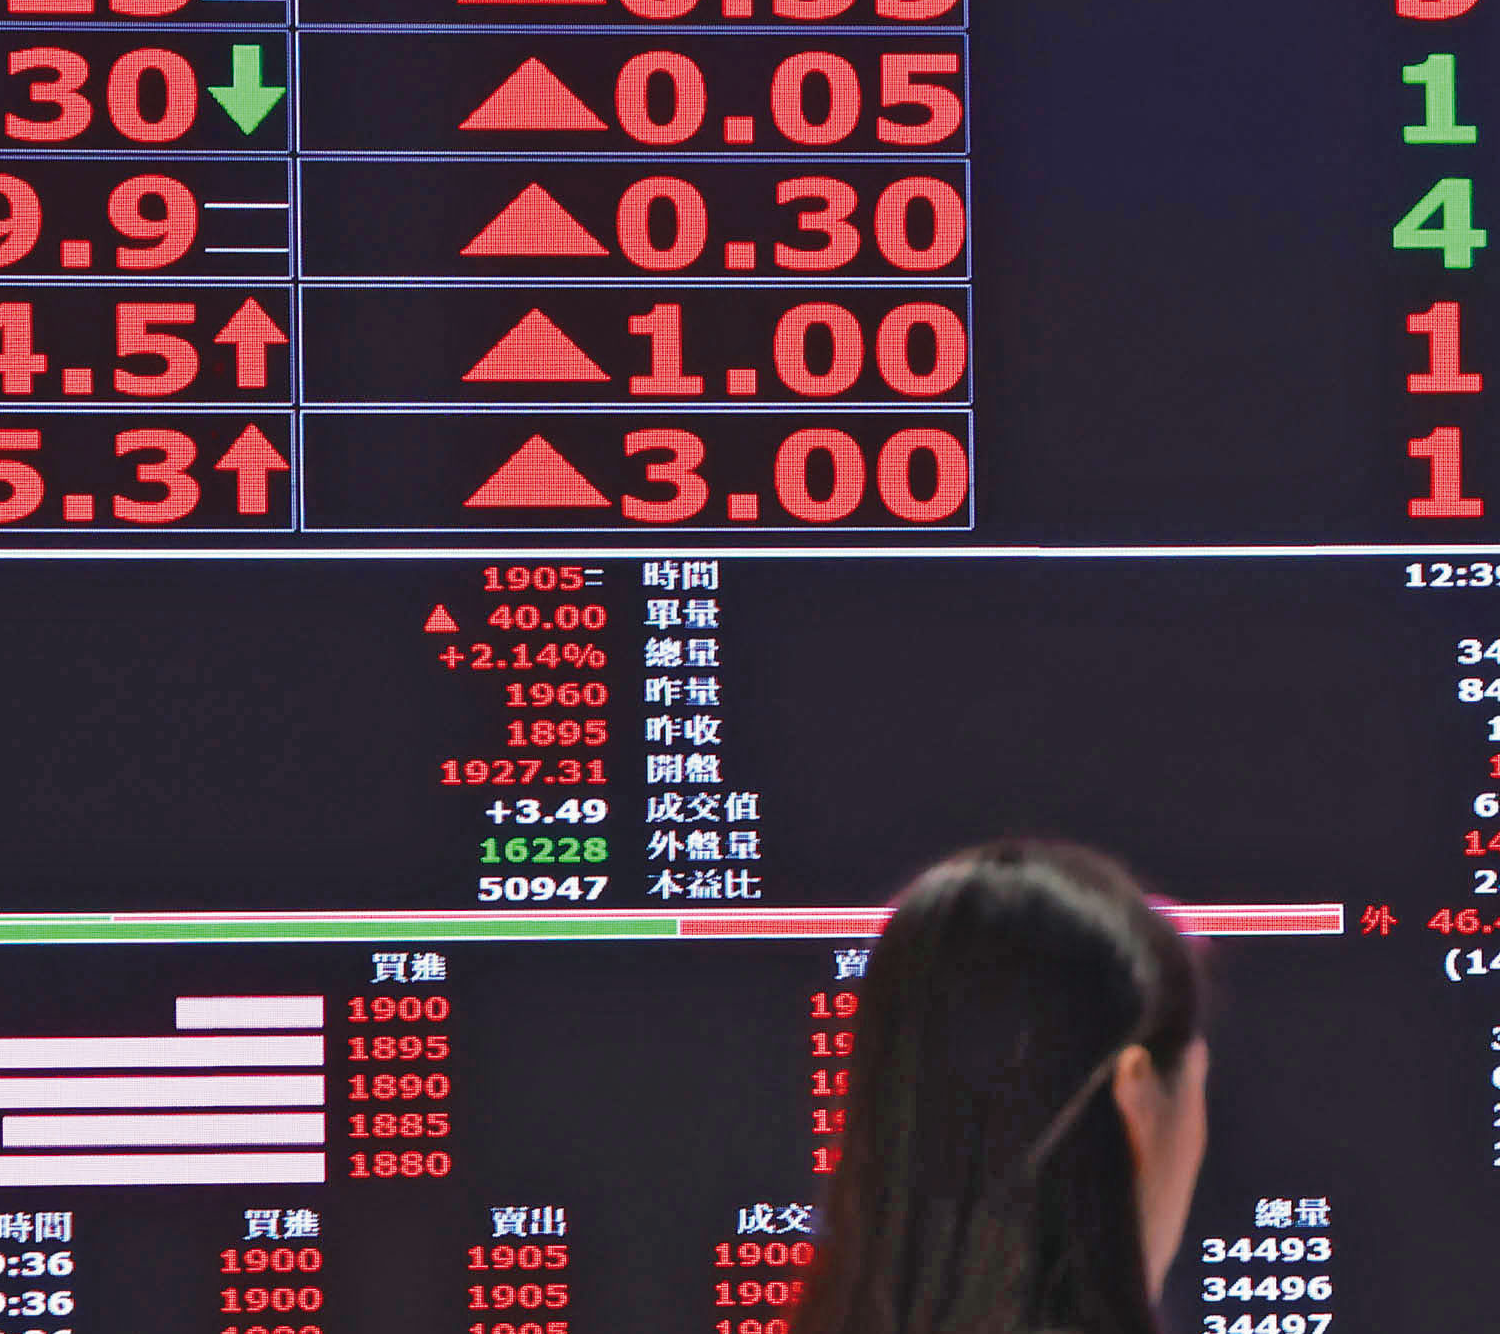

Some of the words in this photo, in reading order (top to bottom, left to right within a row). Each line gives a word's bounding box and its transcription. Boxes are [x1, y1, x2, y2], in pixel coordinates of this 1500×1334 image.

[614, 50, 963, 146] 0.05
[1402, 53, 1478, 145] 1
[621, 427, 969, 524] 3.00
[1407, 426, 1484, 518] 1
[639, 557, 719, 591] 時間
[487, 603, 607, 631] 40.00
[643, 598, 721, 630] 單量
[438, 642, 607, 670] +2.14%
[643, 636, 720, 668] 總量
[505, 682, 609, 708] 1960
[643, 675, 722, 707] 昨量
[507, 719, 609, 748] 1895
[644, 714, 723, 747] 昨收
[440, 758, 608, 786] 1927.31
[646, 752, 724, 785] 開盤
[485, 798, 609, 825] +3.49
[479, 836, 609, 864] 16228
[477, 876, 608, 902] 50947
[1359, 904, 1399, 936] 外
[243, 1208, 321, 1241] 買進
[490, 1205, 568, 1238] 賣出
[219, 1247, 323, 1274] 1900
[467, 1244, 570, 1271] 1905
[1201, 1236, 1333, 1264] 34493
